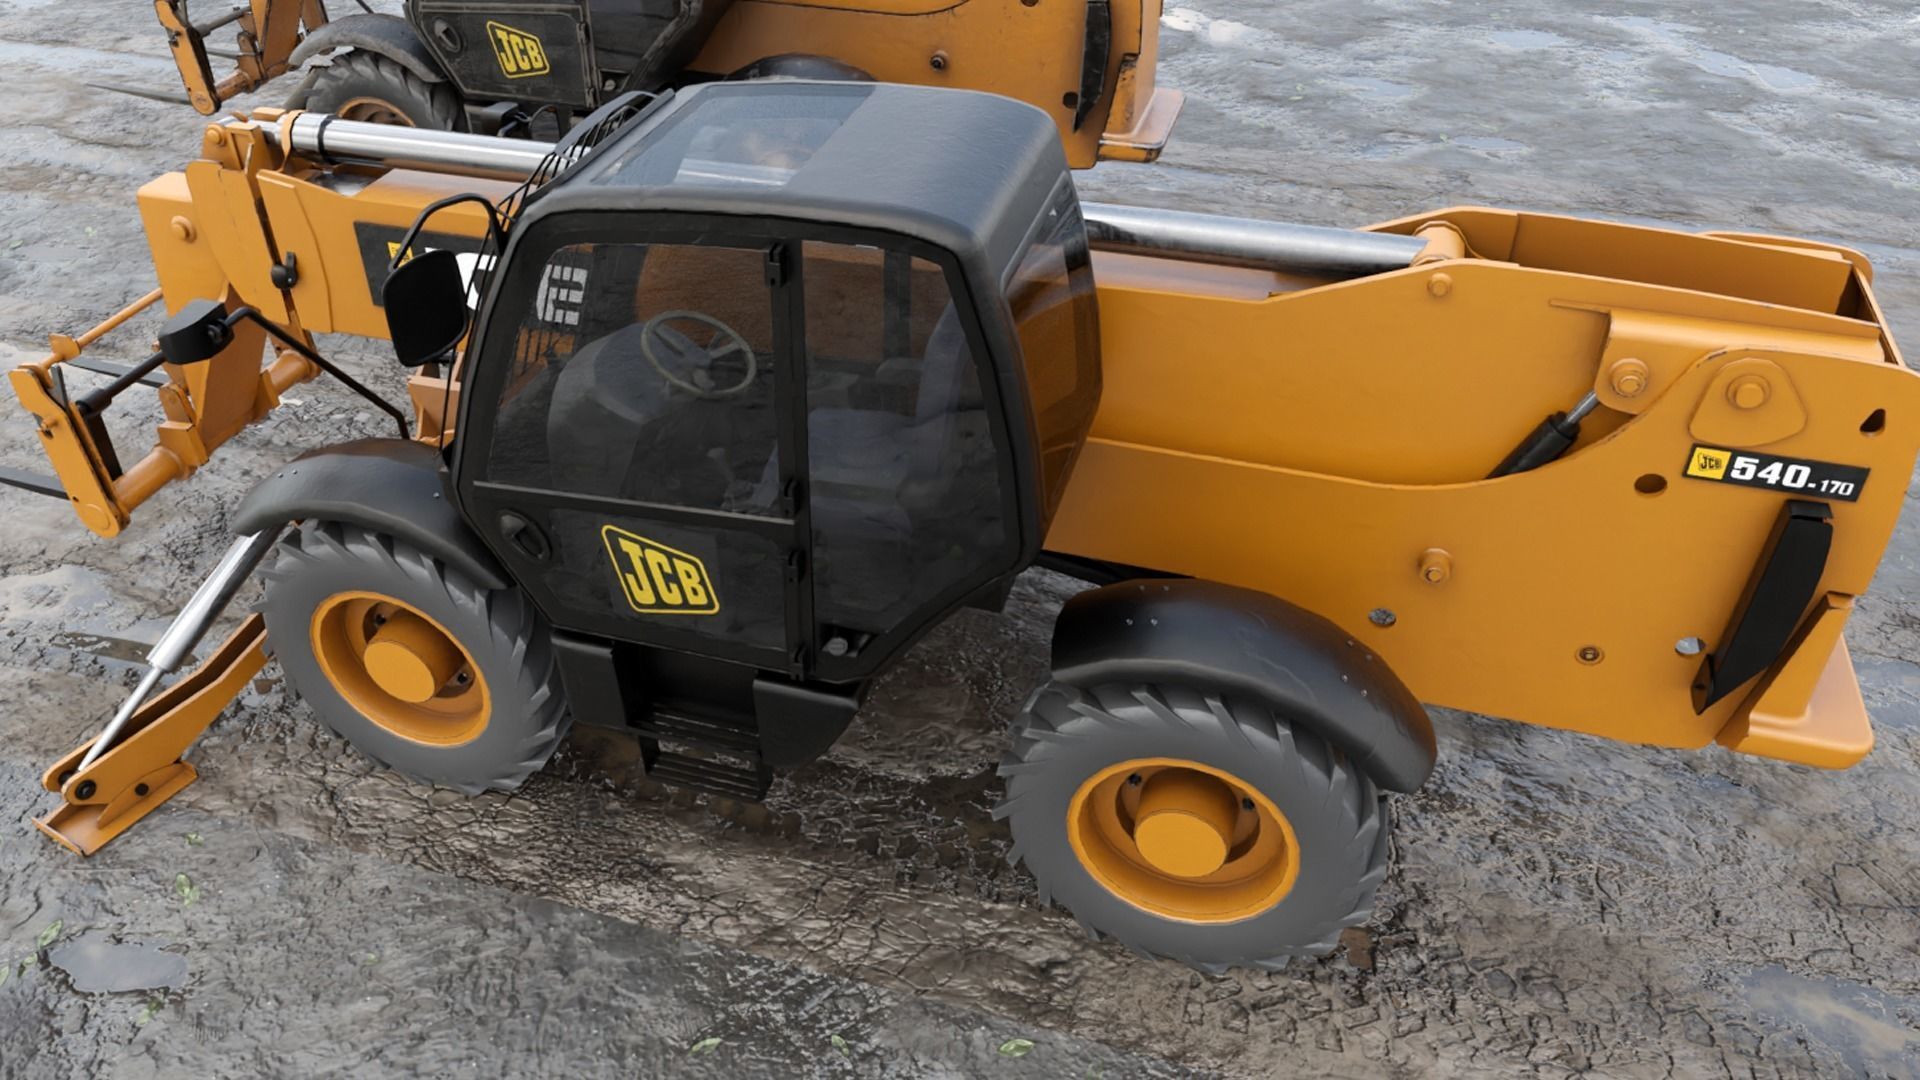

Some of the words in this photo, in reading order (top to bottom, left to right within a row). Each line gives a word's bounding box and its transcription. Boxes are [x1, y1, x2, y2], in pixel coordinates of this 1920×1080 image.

[494, 27, 545, 73] JCB
[1730, 456, 1855, 496] 540-170
[617, 536, 709, 605] JCB
